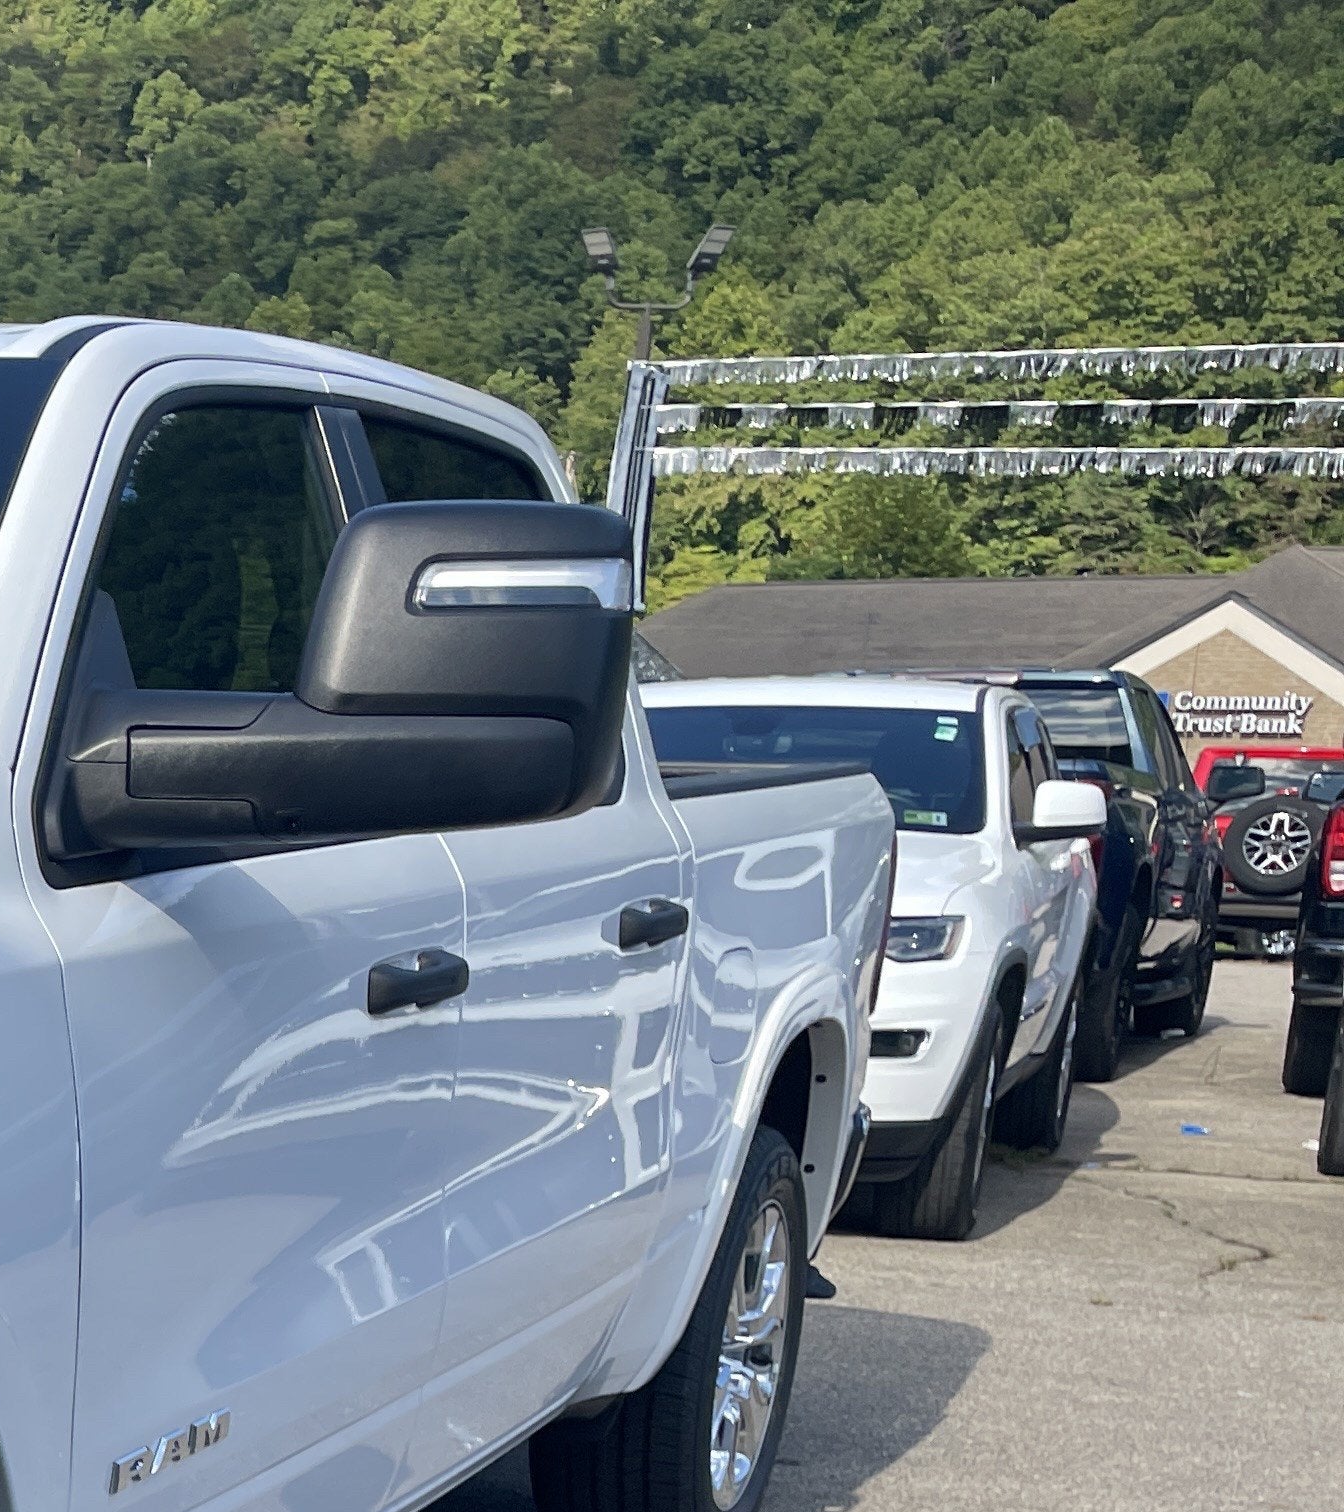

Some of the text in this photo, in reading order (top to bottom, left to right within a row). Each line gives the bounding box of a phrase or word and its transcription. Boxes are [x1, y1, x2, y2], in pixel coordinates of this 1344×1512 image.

[1174, 690, 1313, 716] Community
[1172, 712, 1303, 734] Trust Bank
[109, 1407, 232, 1496] RAM
